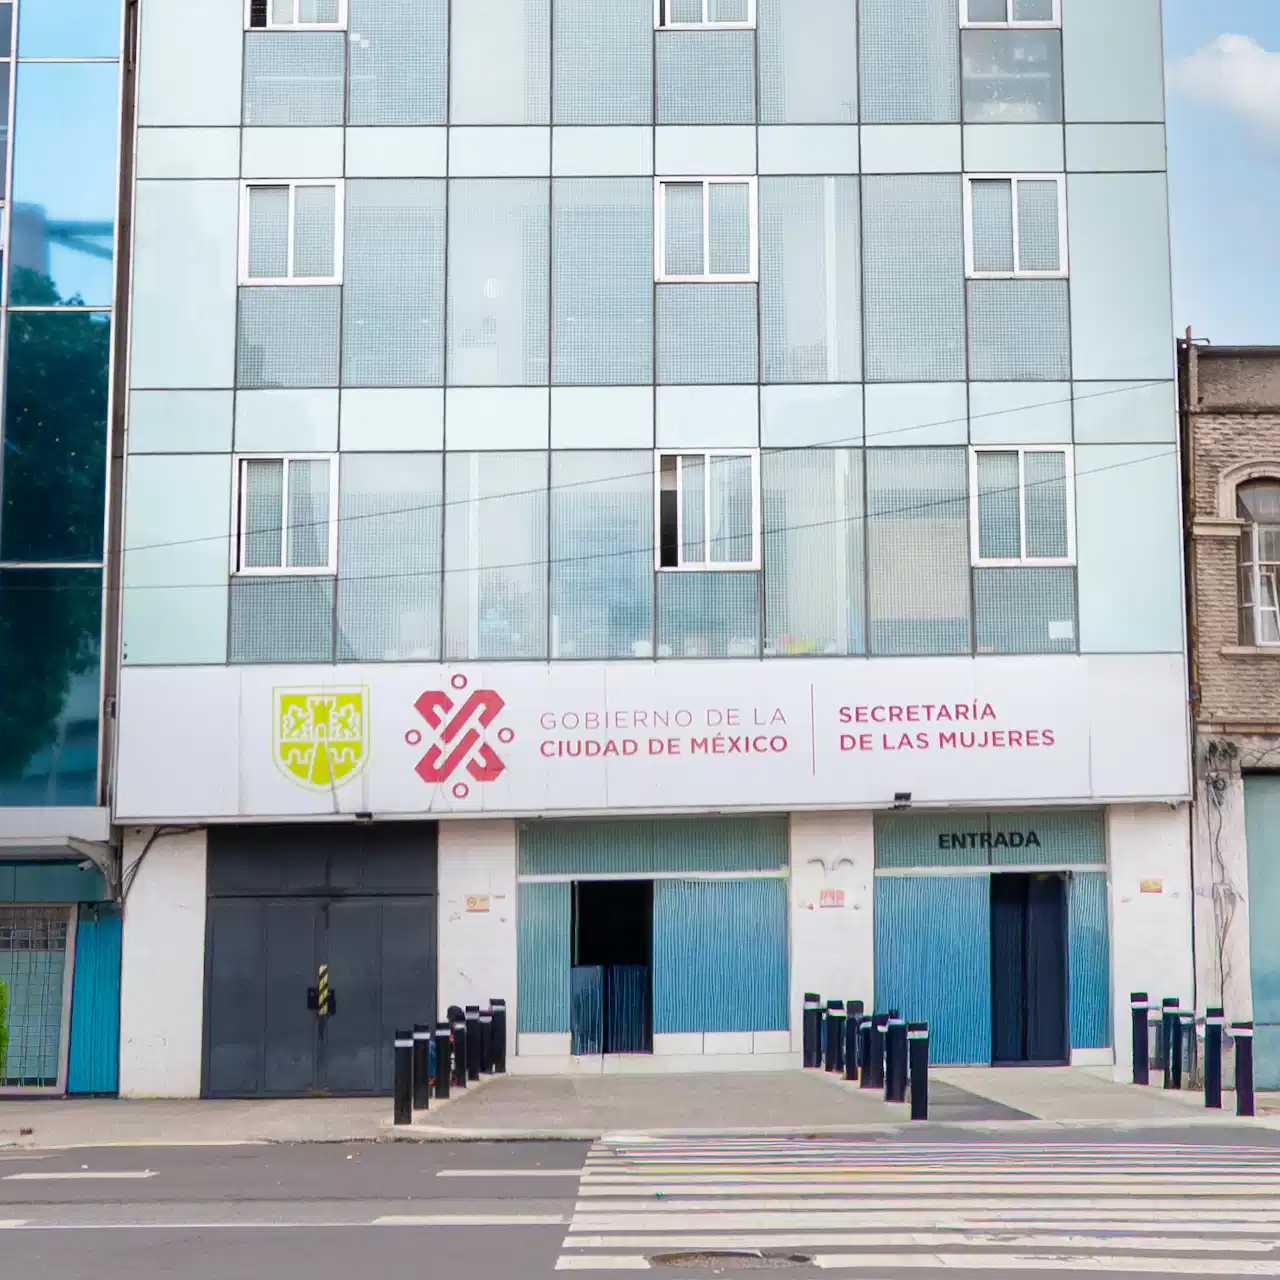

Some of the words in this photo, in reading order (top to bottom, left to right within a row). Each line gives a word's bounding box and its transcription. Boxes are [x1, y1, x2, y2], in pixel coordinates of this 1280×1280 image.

[540, 709, 693, 730] GOBIERNO
[706, 708, 741, 727] DE
[754, 707, 788, 726] LA
[839, 699, 997, 723] SECRETARÍA
[540, 739, 639, 758] CIUDAD
[648, 738, 681, 756] DE
[691, 732, 788, 755] MÉXICO
[839, 733, 873, 752] DE
[882, 732, 930, 751] LAS
[939, 729, 1055, 750] MUJERES
[938, 830, 1041, 849] ENTRADA
